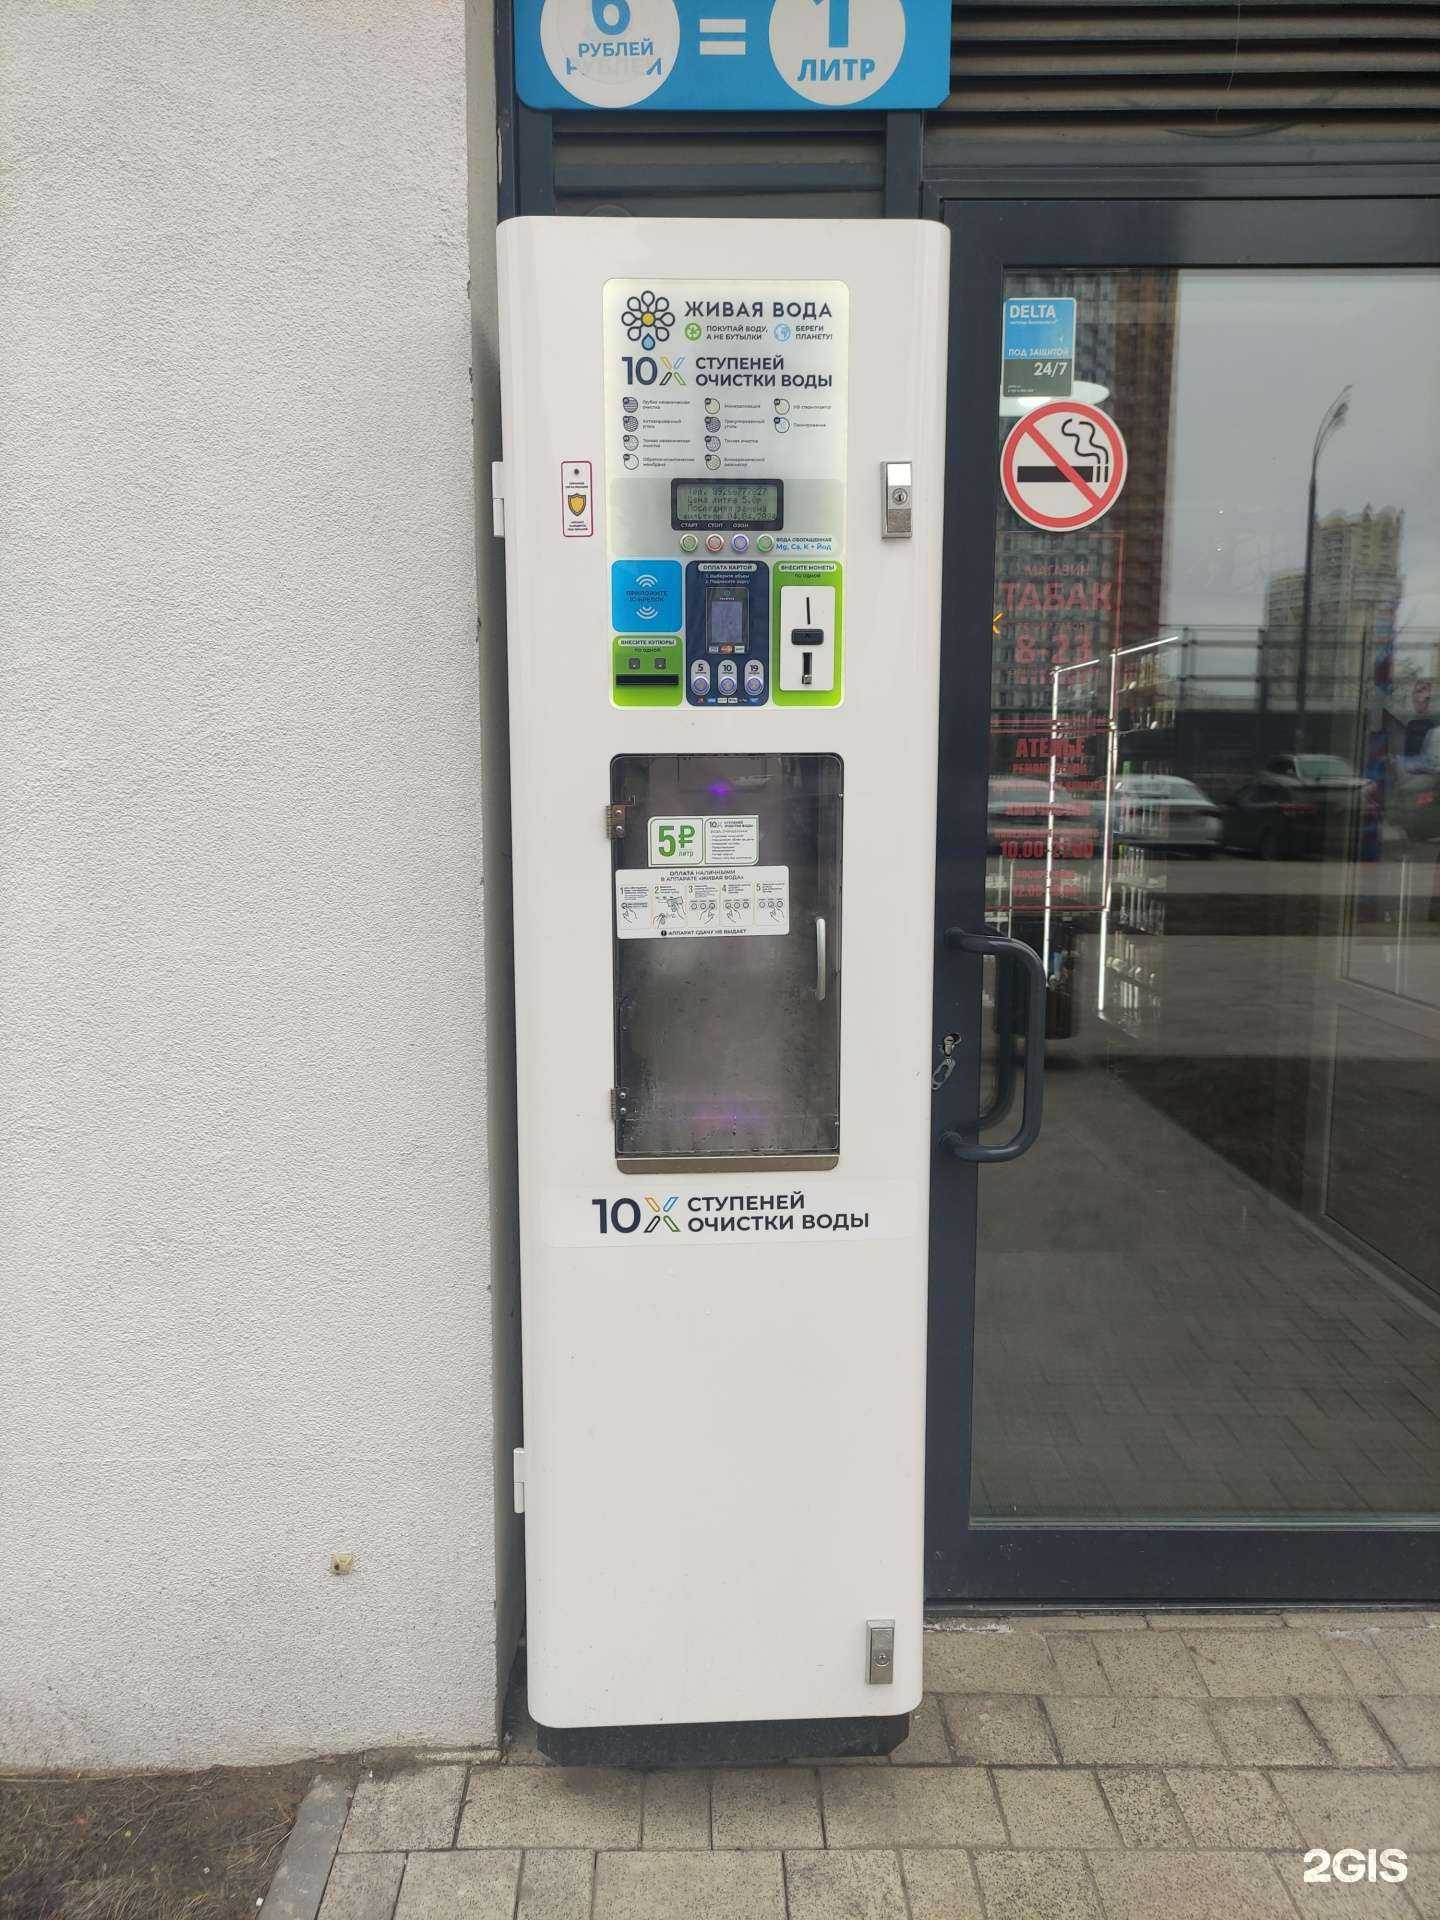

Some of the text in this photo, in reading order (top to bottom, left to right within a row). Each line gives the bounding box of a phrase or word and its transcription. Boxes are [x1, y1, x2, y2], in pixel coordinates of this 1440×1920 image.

[578, 38, 654, 57] РУБЛЕЙ
[796, 58, 876, 82] ЛИТР
[685, 301, 832, 320] ЖИВАЯ ВОДА
[1009, 304, 1056, 318] DELTA
[706, 324, 743, 332] ПОКУПАЙ
[1008, 348, 1027, 357] ПОД
[695, 355, 784, 370] СТУПЕНЕЙ
[1033, 361, 1068, 378] 24/7
[695, 374, 832, 388] ОЧИСТКИ ВОДЫ
[998, 580, 1113, 611] ТАБАК
[697, 663, 704, 672] 5
[722, 664, 733, 672] 10
[749, 664, 759, 672] 19
[687, 1191, 805, 1212] СТУПЕНЕЙ
[687, 1213, 869, 1233] ОЧИСТКИ ВОДЫ
